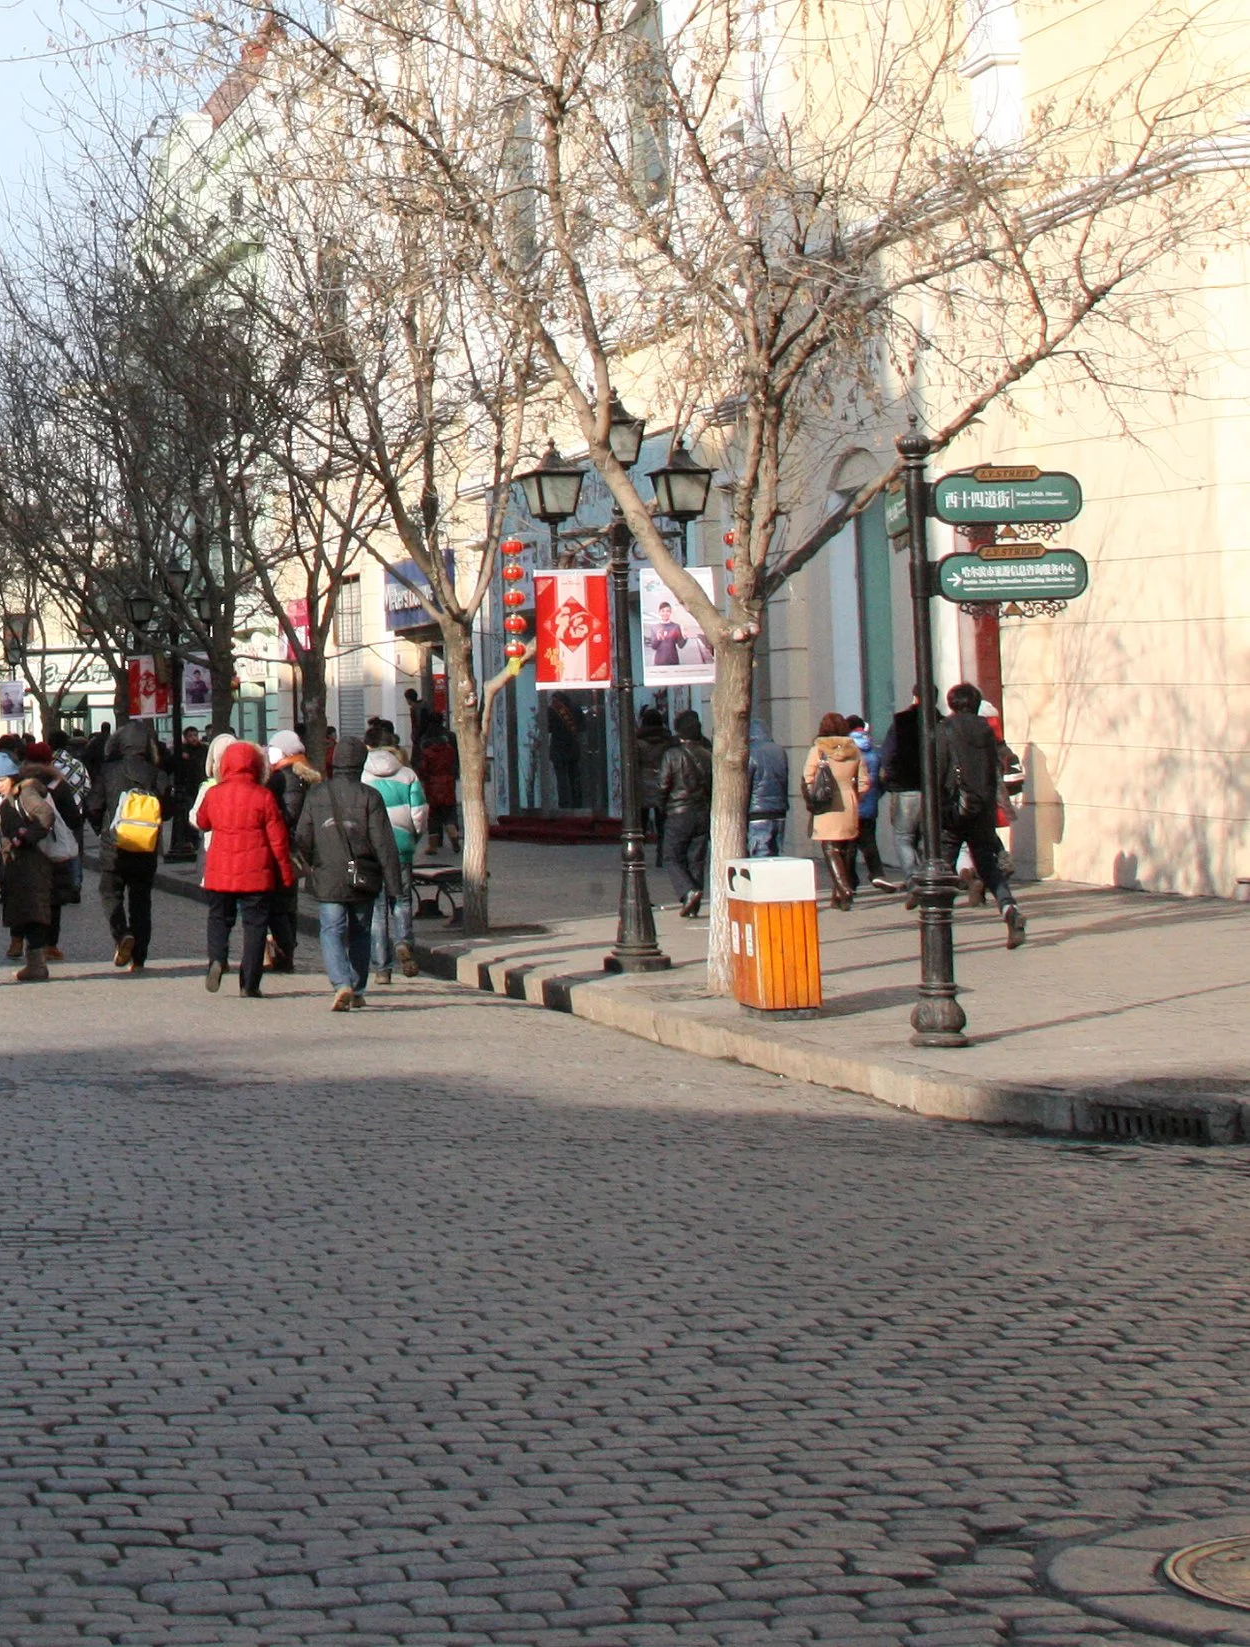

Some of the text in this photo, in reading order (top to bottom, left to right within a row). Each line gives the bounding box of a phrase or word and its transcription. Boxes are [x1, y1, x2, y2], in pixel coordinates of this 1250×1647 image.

[945, 489, 1010, 509] 西十四道街
[555, 606, 590, 639] 福
